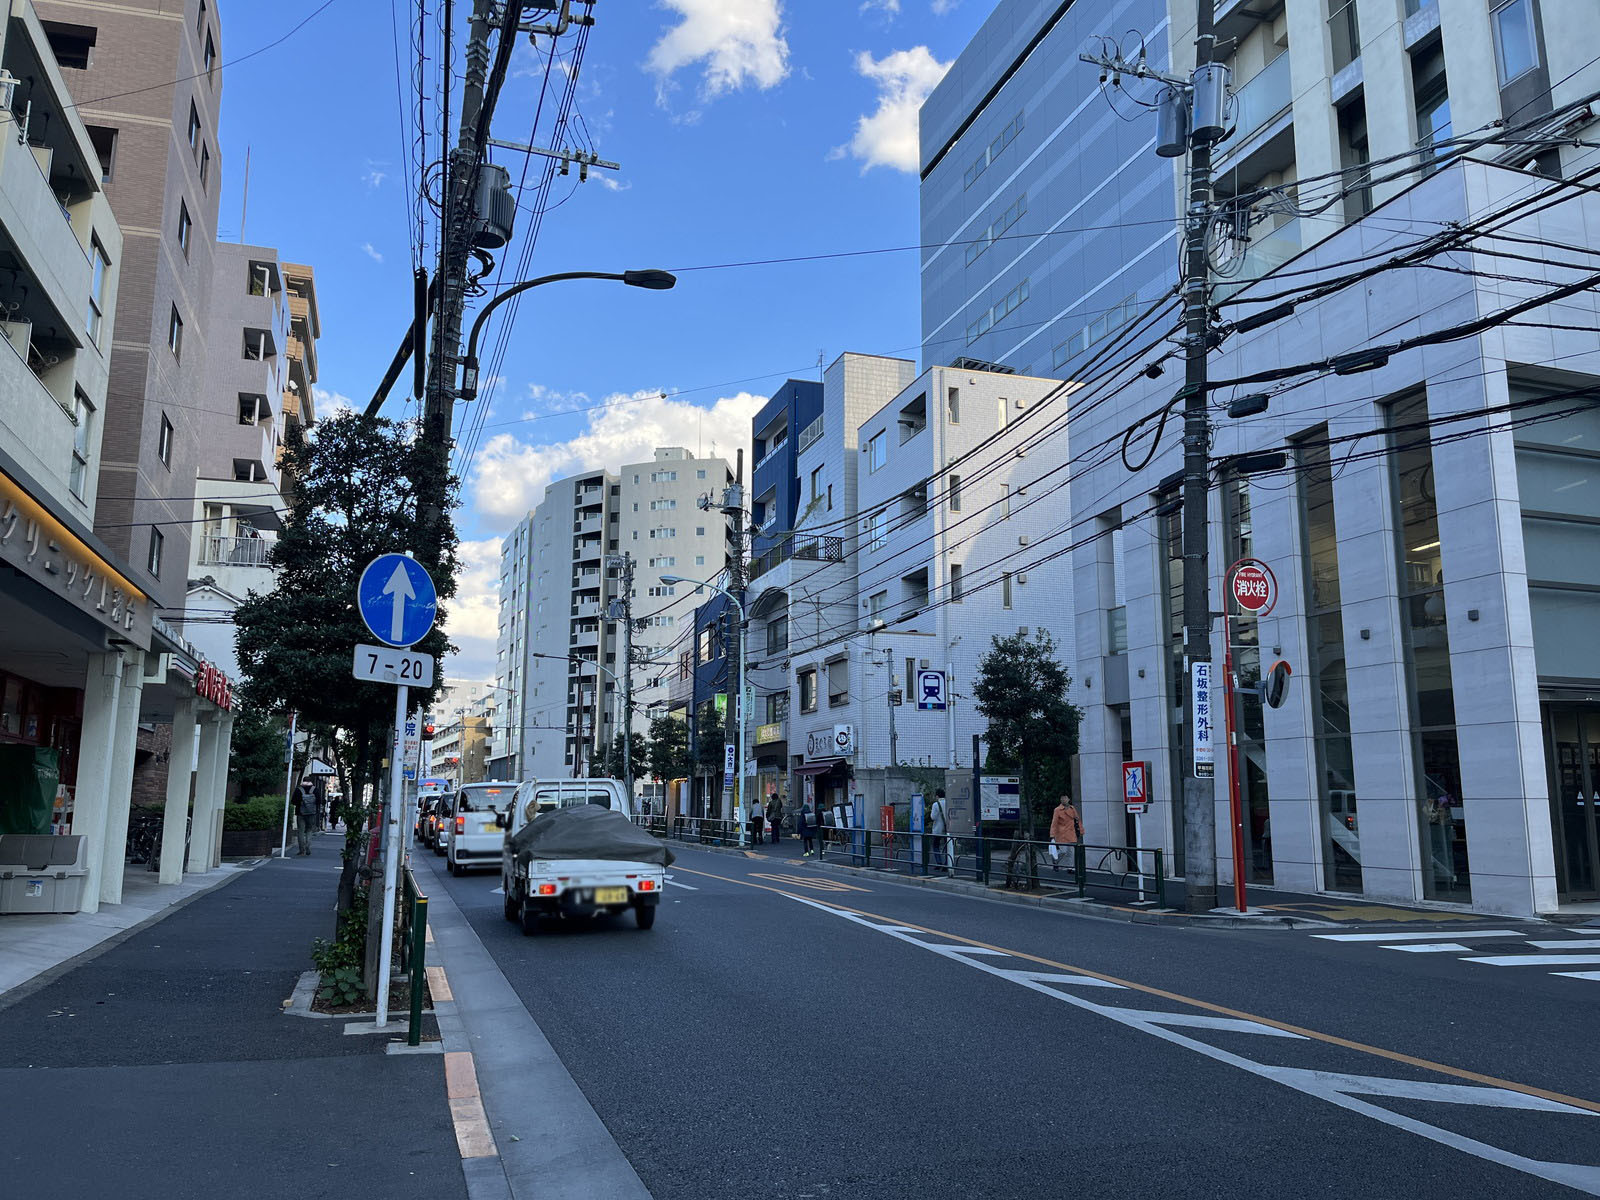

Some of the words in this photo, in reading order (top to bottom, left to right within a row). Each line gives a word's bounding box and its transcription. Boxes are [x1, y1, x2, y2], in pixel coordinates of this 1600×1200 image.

[1236, 579, 1267, 598] 消火栓
[1196, 664, 1209, 742] 石坂整形外科
